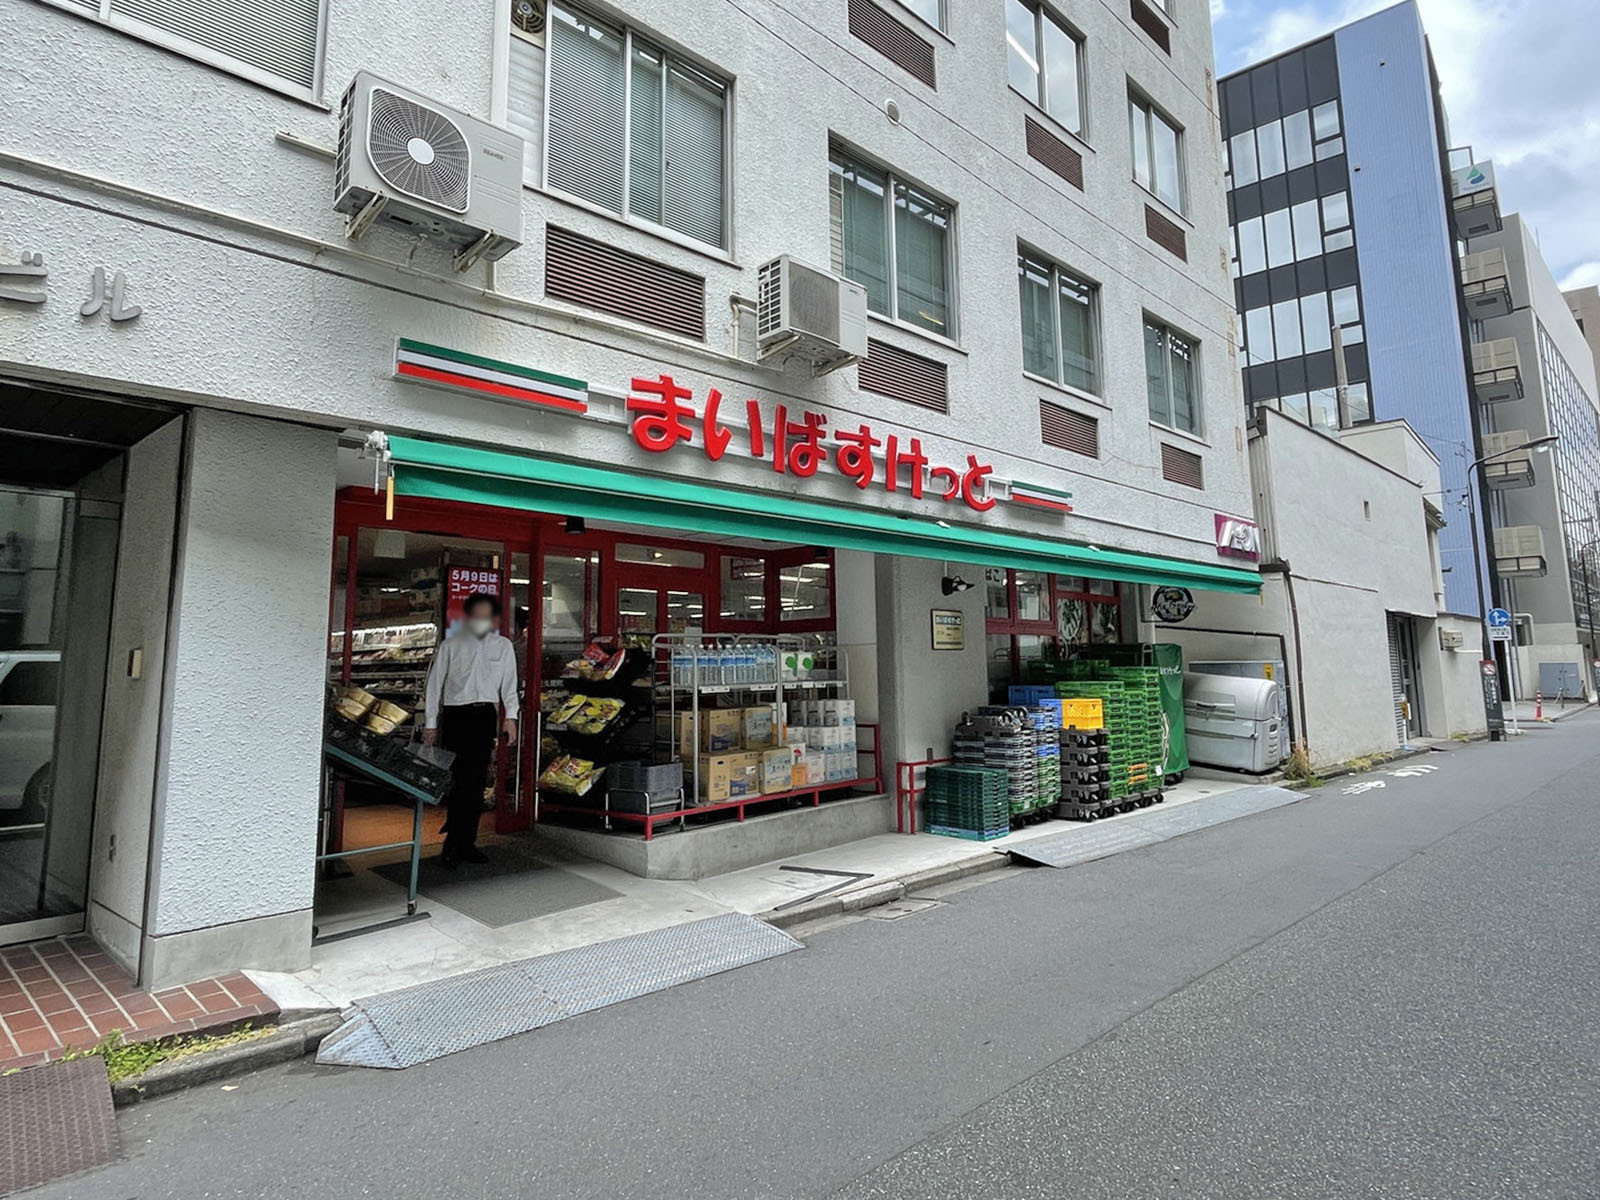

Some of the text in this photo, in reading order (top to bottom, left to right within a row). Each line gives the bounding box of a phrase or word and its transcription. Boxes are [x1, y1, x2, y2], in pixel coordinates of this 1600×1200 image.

[626, 374, 998, 512] まいばすけっと
[452, 569, 498, 583] 5月9日は
